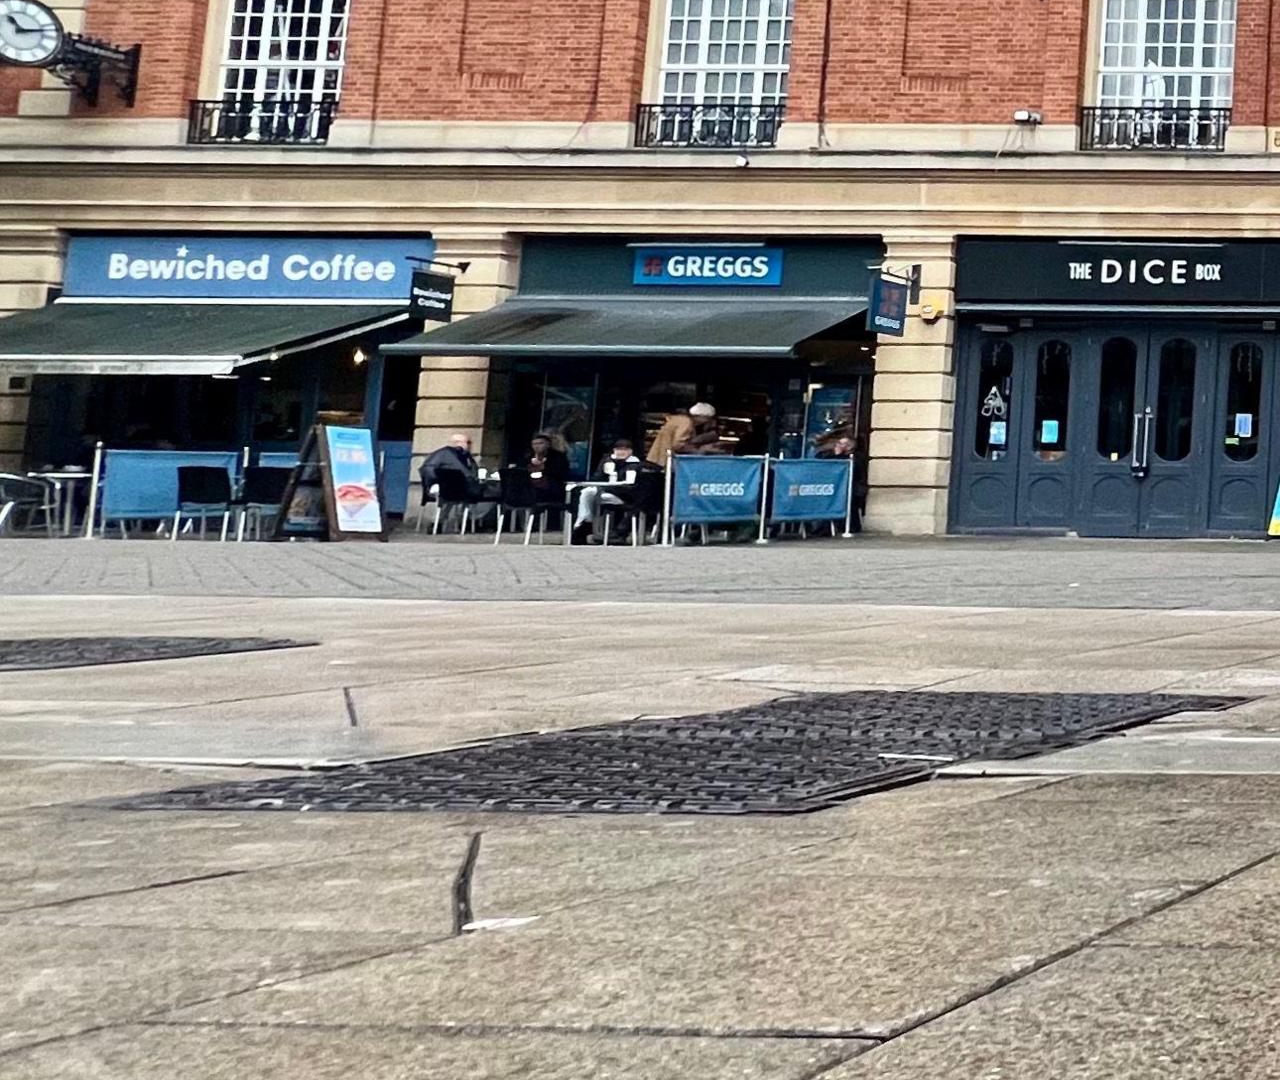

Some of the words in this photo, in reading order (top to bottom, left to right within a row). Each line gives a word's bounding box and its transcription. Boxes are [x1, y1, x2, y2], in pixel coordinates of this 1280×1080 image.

[108, 246, 270, 280] Bewiched
[283, 254, 396, 281] Coffee
[667, 256, 769, 277] GREGGS
[1068, 262, 1093, 280] THE
[1100, 259, 1188, 285] DICE
[1195, 264, 1221, 281] BOX
[700, 483, 745, 496] GREGGS
[799, 484, 835, 496] GREGGS
